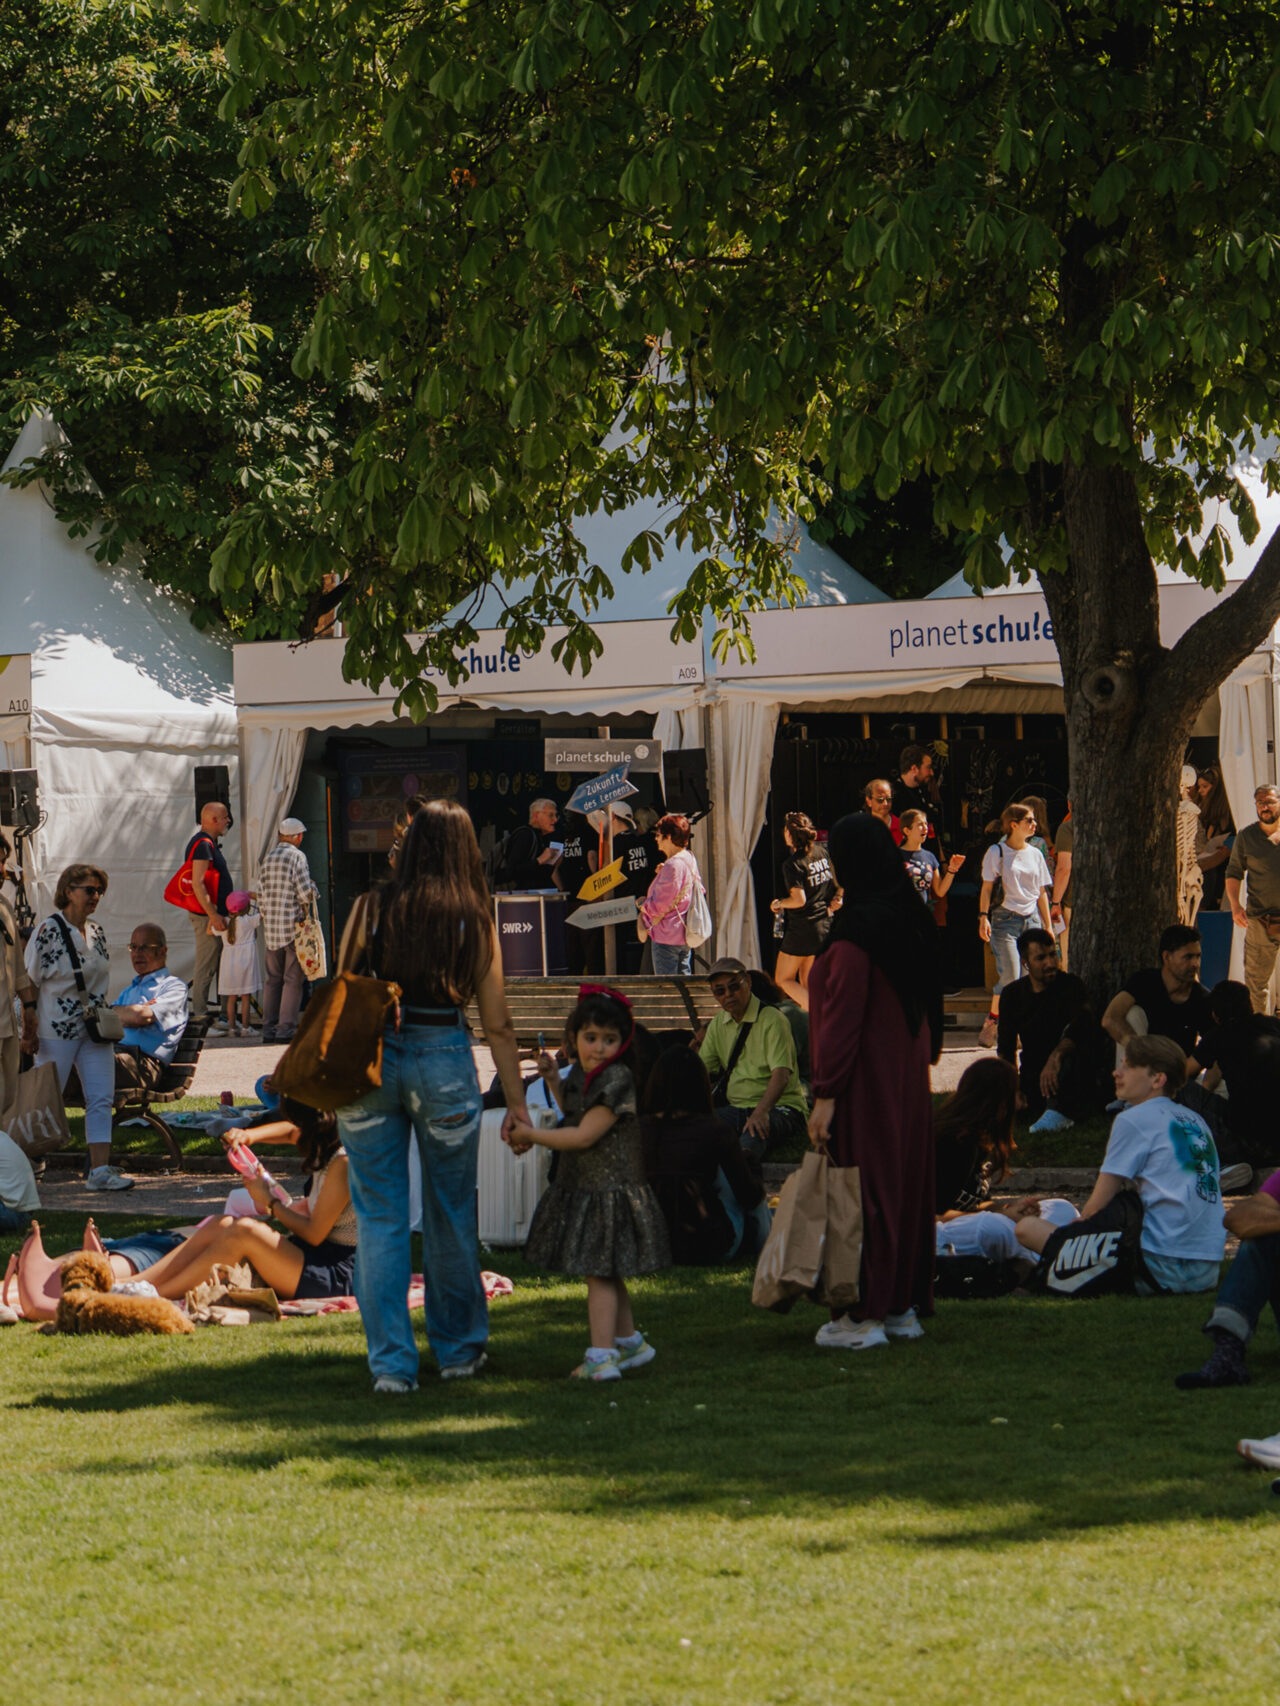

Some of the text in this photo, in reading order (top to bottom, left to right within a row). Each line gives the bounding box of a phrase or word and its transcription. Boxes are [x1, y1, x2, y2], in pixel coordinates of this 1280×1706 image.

[679, 667, 697, 679] A09
[9, 699, 29, 712] A10
[586, 773, 620, 796] Zukunft
[583, 784, 630, 811] des Lernens
[808, 858, 830, 875] SWR
[593, 874, 612, 892] Filme
[807, 870, 833, 887] TEAM
[587, 906, 629, 920] Webseite
[1055, 1231, 1122, 1272] NIKE
